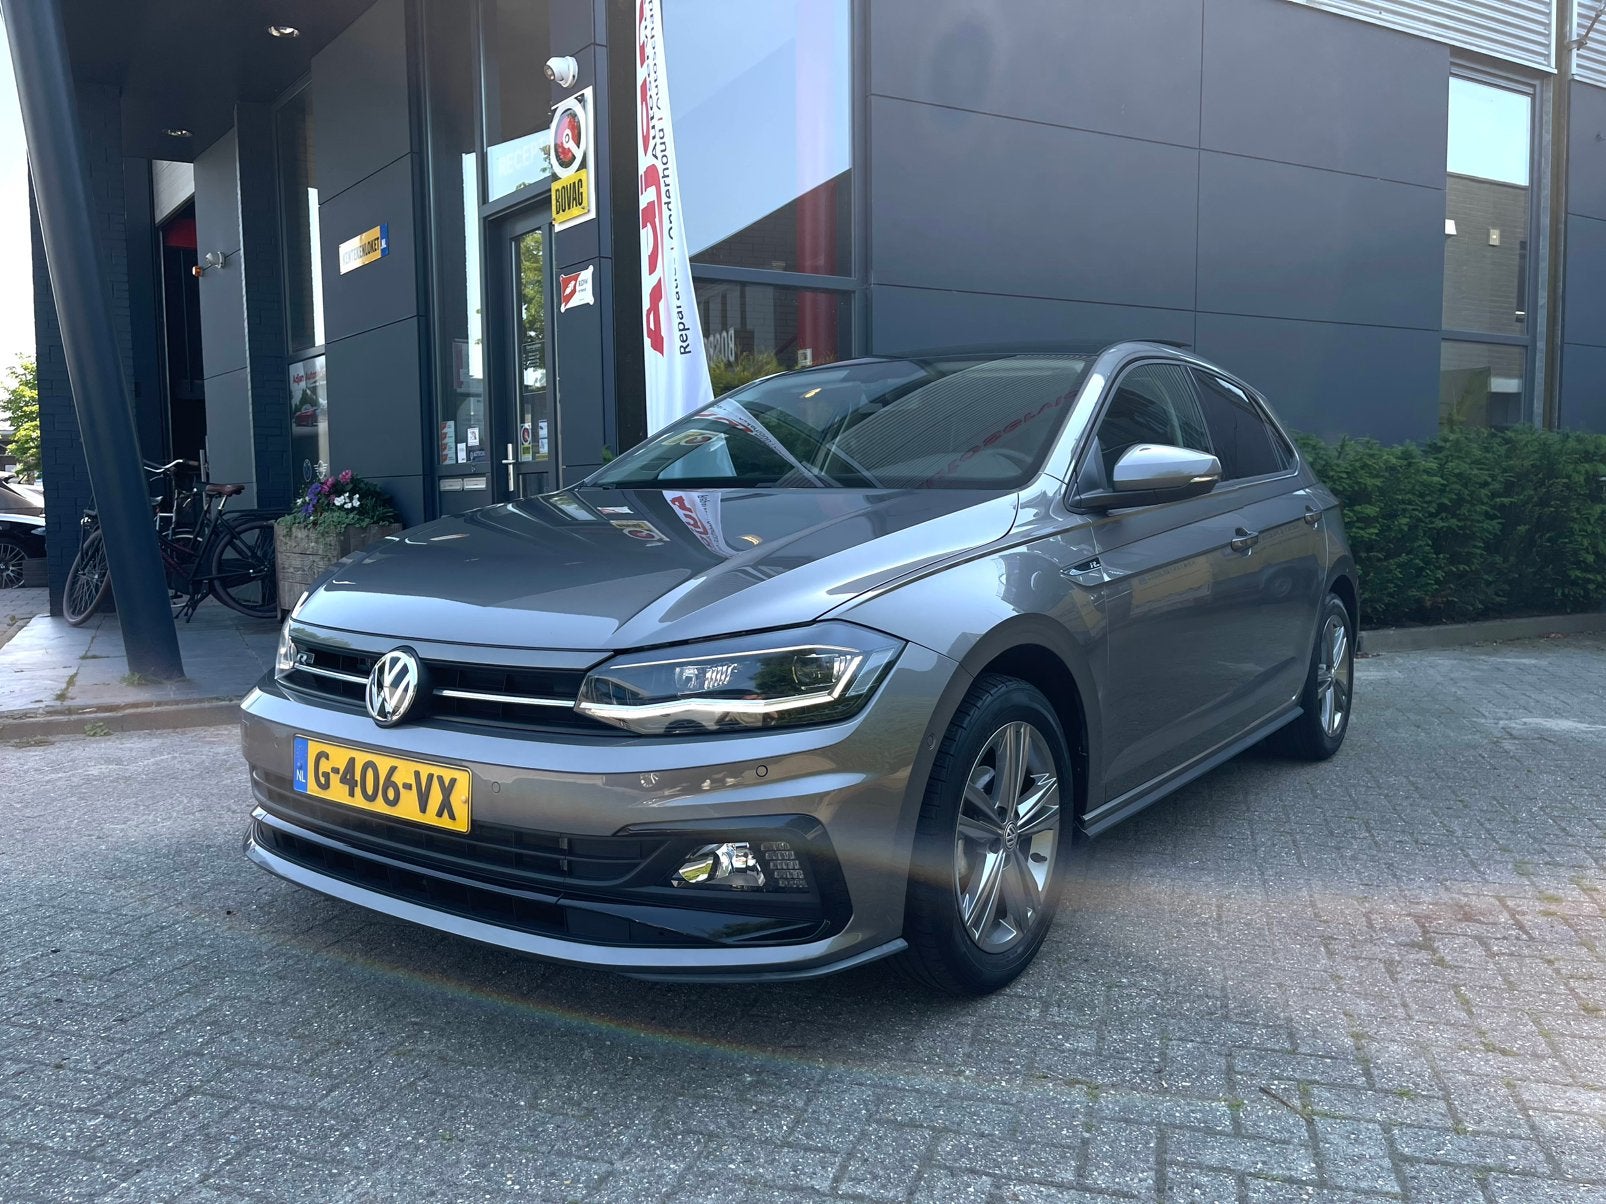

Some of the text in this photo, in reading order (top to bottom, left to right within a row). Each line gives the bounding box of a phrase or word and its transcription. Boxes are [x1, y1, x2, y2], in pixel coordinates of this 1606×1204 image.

[555, 178, 584, 215] BOVAG
[295, 750, 458, 821] NL G-406-VX
